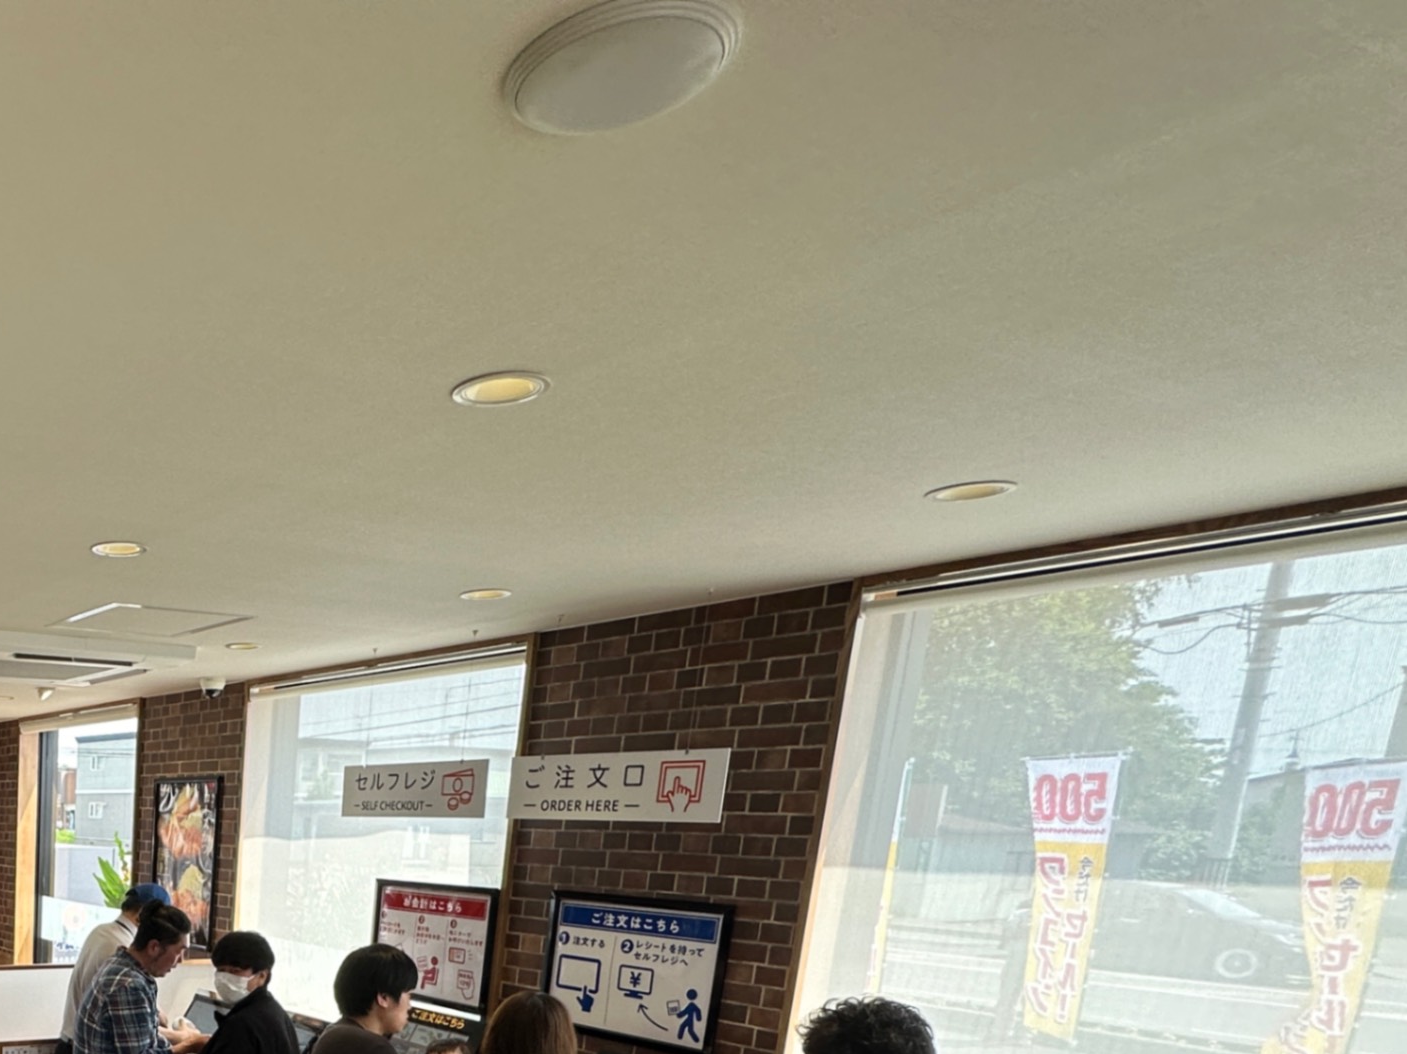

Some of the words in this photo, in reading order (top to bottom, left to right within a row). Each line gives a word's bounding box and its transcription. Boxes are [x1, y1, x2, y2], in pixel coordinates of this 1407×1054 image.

[355, 769, 436, 791] セルフレジ
[525, 763, 645, 789] ご注文口
[361, 800, 377, 811] SELF
[379, 800, 425, 811] CHECKOUT
[540, 799, 582, 812] ORDER
[585, 799, 619, 812] HERE
[591, 911, 681, 934] ご注文はこちら
[573, 935, 605, 948] 注文する
[636, 940, 705, 957] レシートを持って
[634, 951, 689, 967] セルフレジへ
